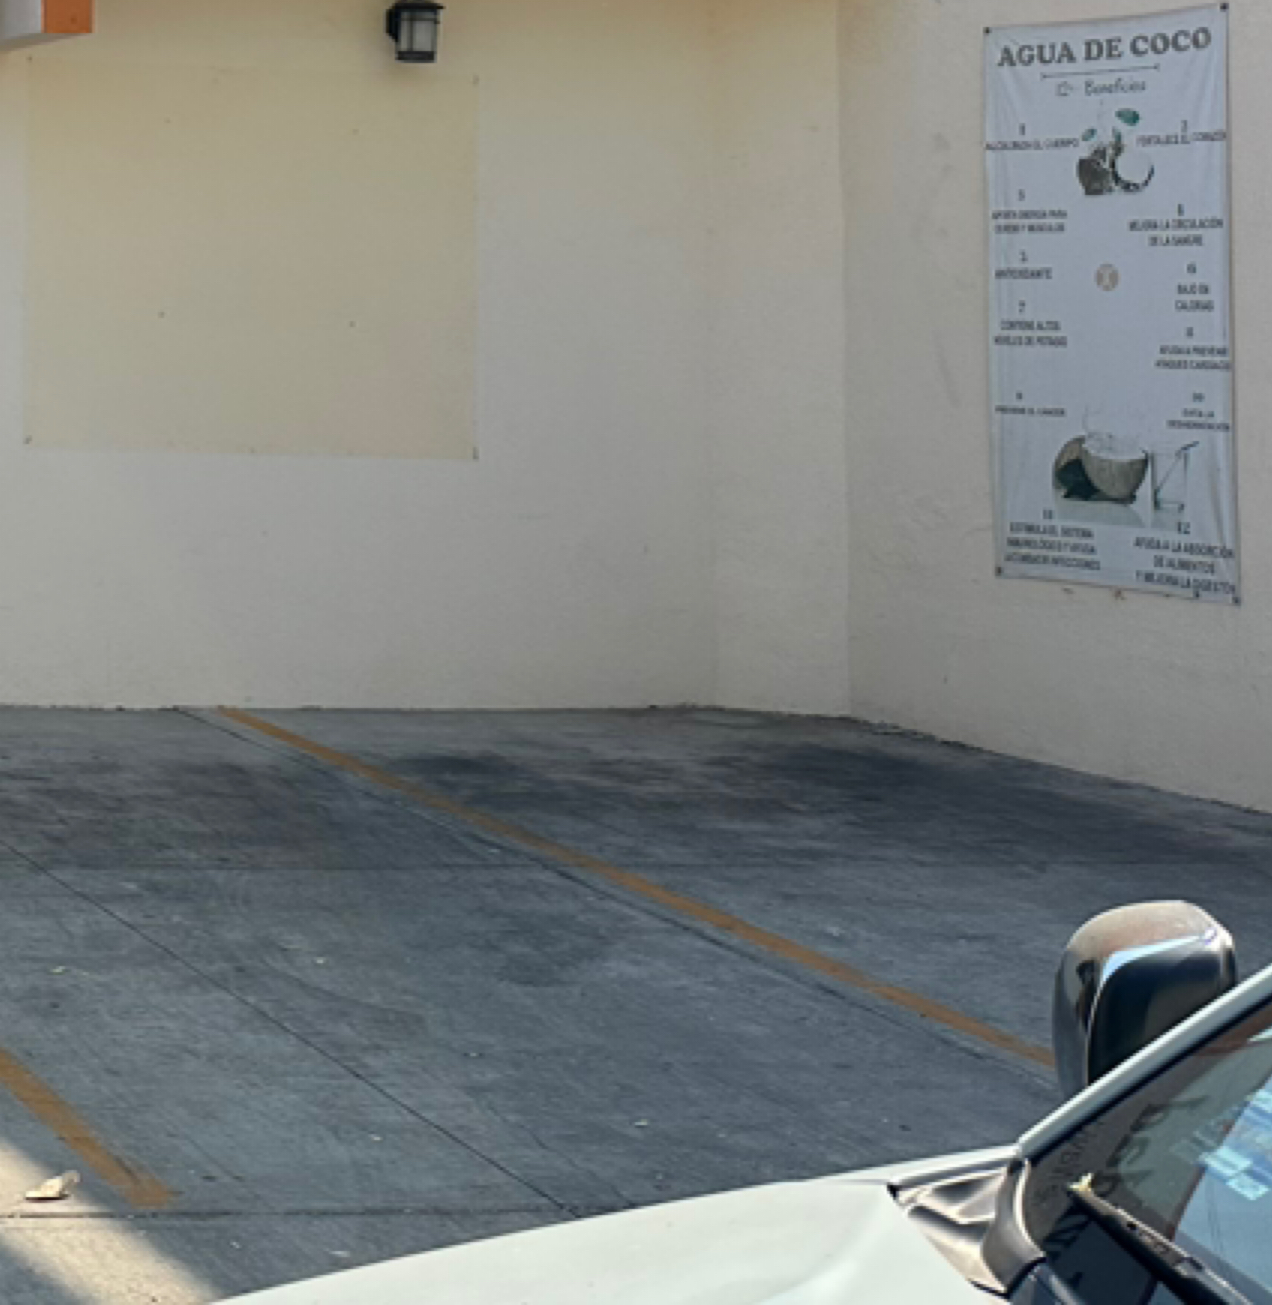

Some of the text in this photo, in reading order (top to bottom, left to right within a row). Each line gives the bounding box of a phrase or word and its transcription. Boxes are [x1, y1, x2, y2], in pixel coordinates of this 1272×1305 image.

[997, 27, 1212, 67] AGUA DE COCO
